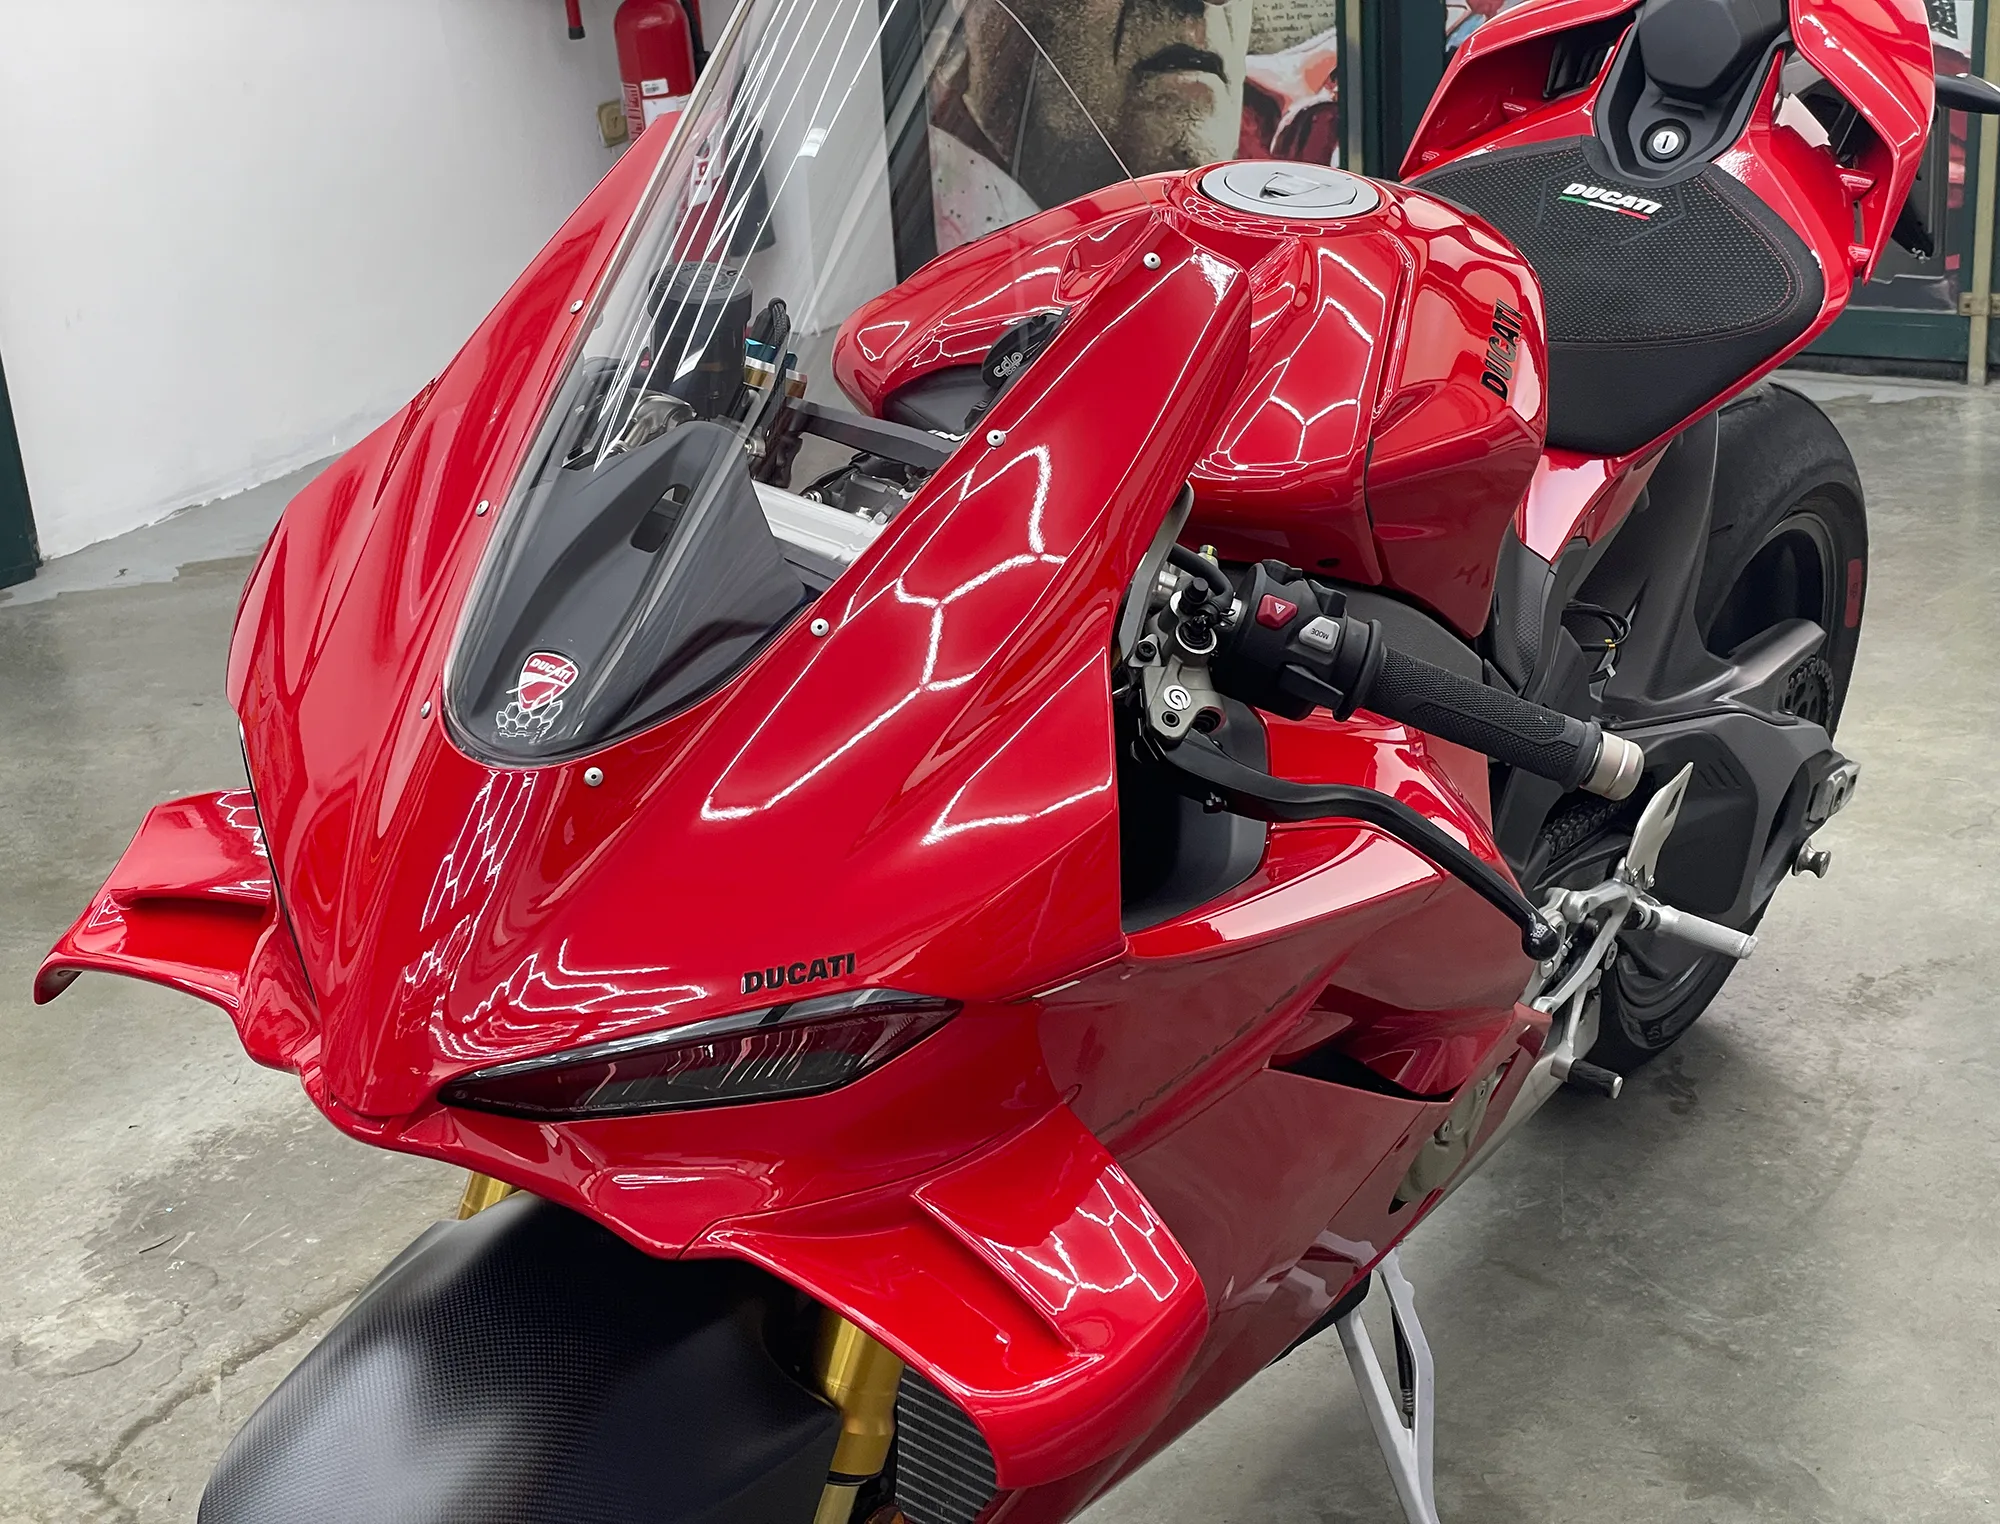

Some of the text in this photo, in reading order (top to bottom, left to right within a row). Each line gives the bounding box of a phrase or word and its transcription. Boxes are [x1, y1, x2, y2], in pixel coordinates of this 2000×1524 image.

[1562, 183, 1663, 214] DUCATI
[1481, 298, 1523, 402] DUCATI
[1311, 627, 1330, 640] MODE
[530, 658, 574, 681] DUCATI
[741, 953, 855, 995] DUCATI
